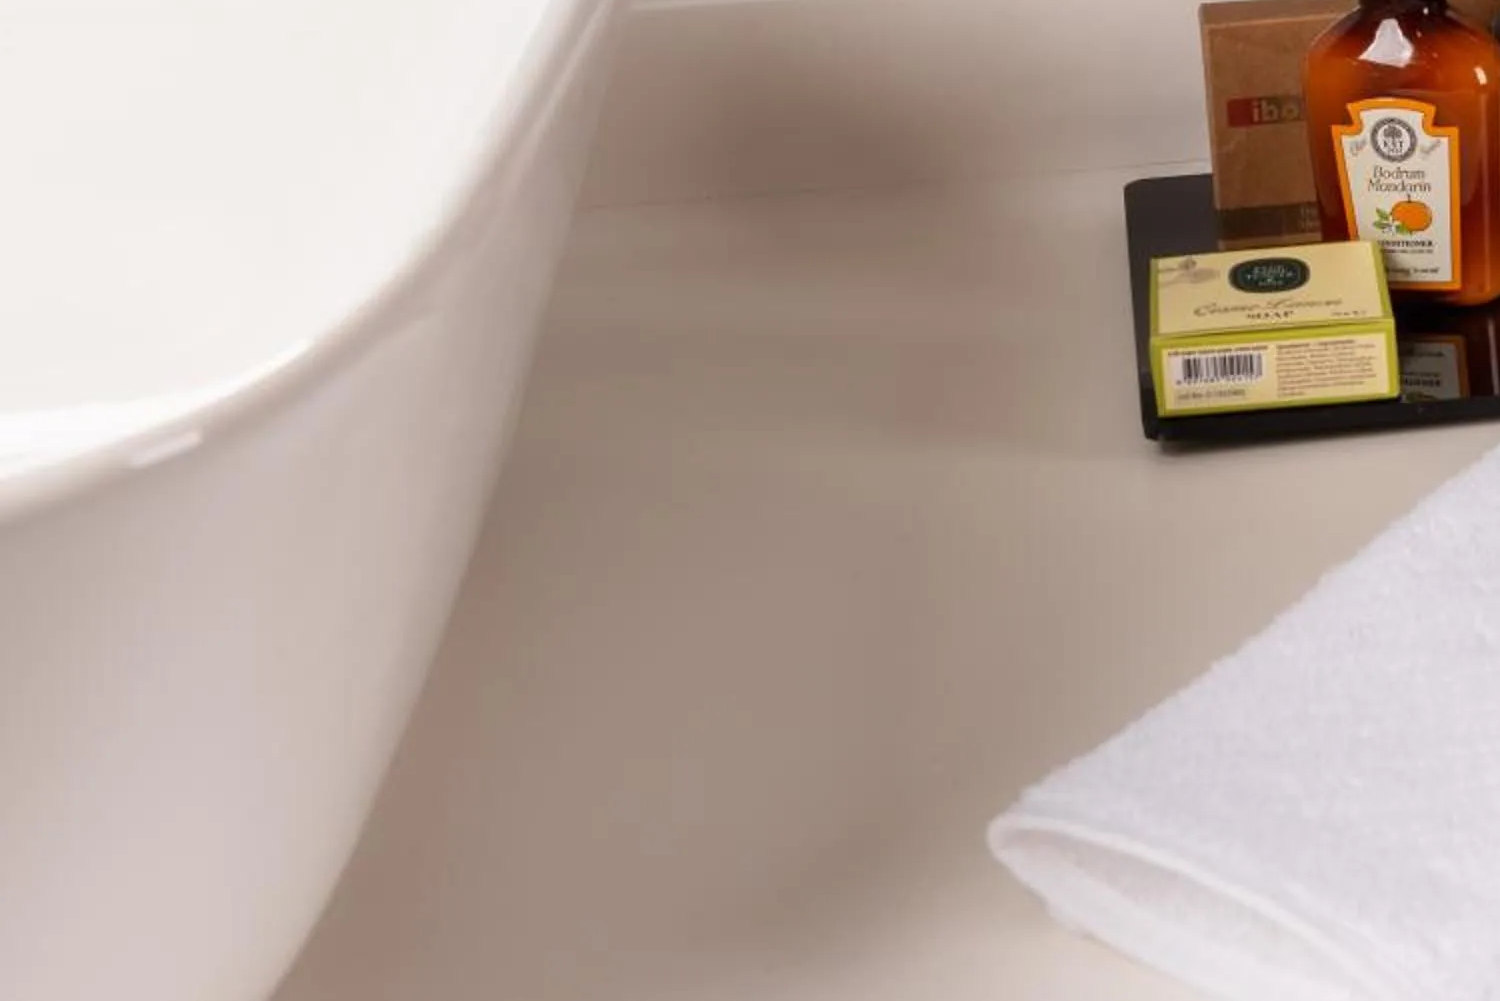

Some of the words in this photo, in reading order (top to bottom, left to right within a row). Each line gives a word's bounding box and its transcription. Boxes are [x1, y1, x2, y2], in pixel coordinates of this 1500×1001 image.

[1251, 100, 1301, 124] ibo
[1373, 165, 1426, 180] Bodrum
[1368, 178, 1433, 194] Mandarin
